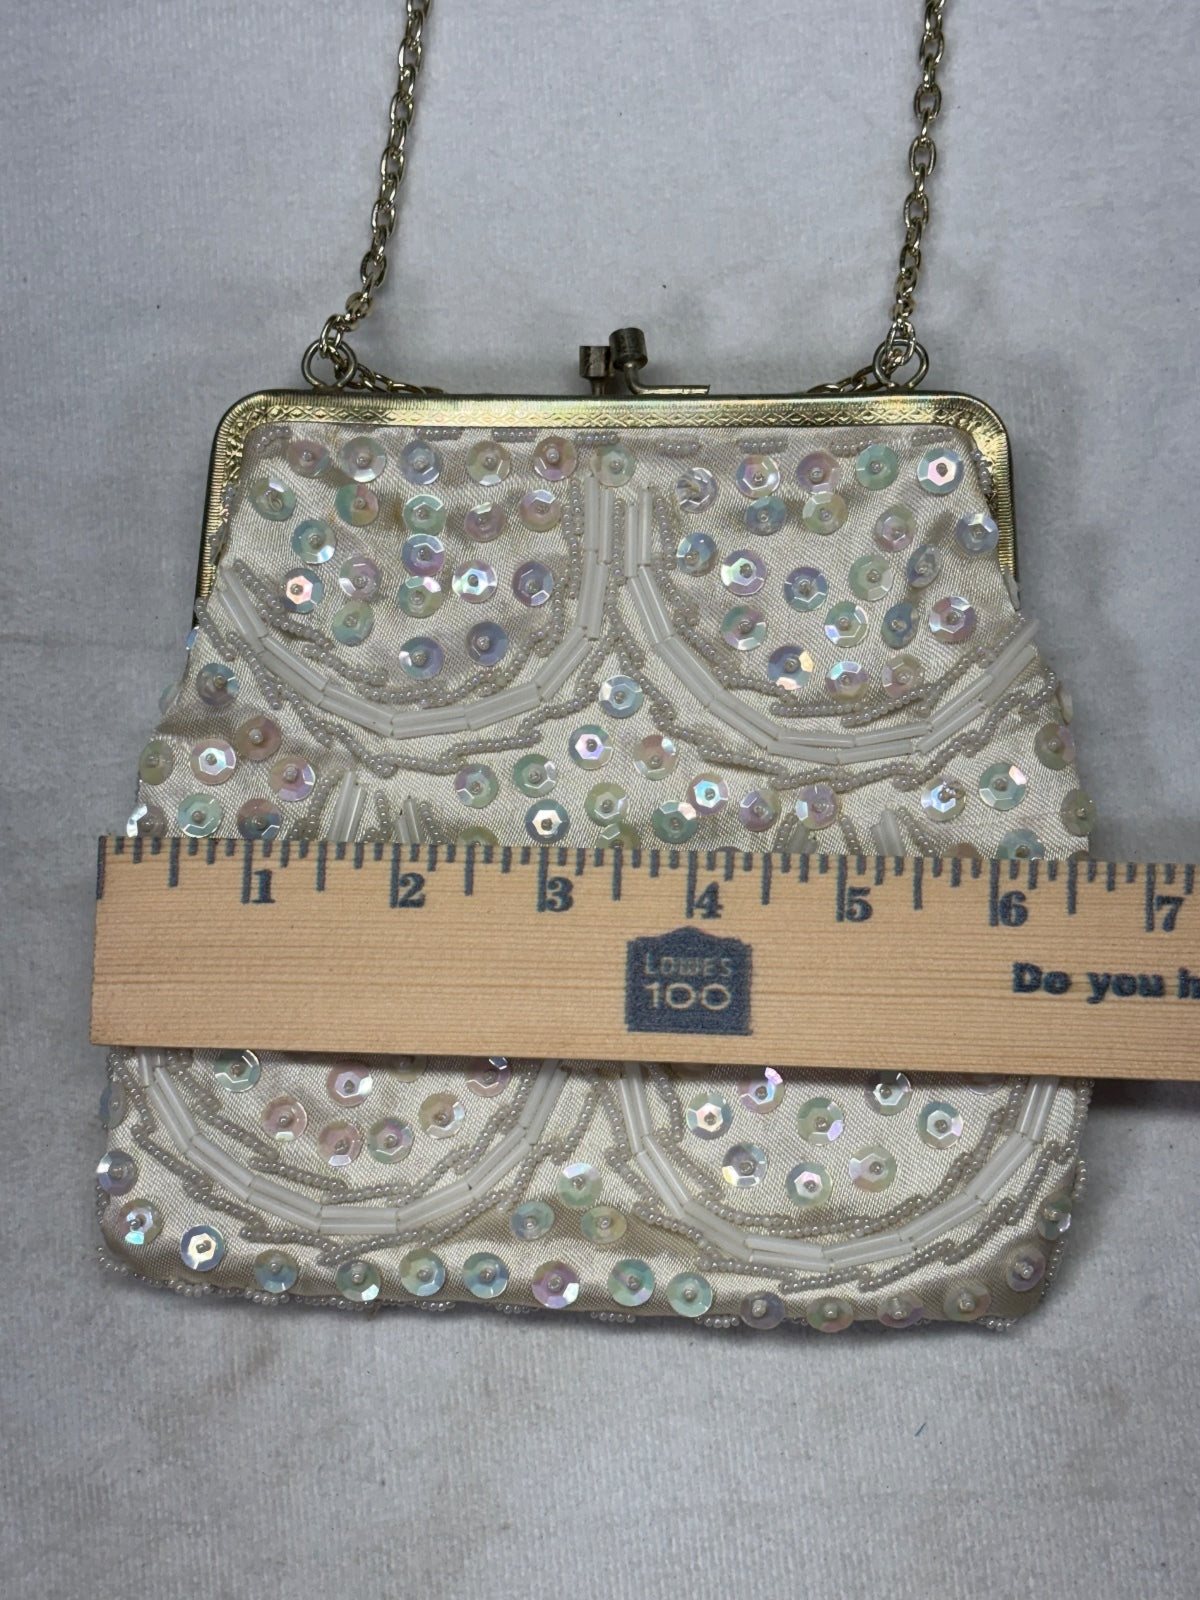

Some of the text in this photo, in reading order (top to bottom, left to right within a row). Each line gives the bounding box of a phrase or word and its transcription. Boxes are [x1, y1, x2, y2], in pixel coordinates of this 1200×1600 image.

[252, 869, 1185, 932] 1 2 3 4 5 6 7
[644, 952, 733, 978] LOWES
[1012, 962, 1072, 995] Do
[1086, 971, 1165, 1004] you
[644, 981, 732, 1011] 100
